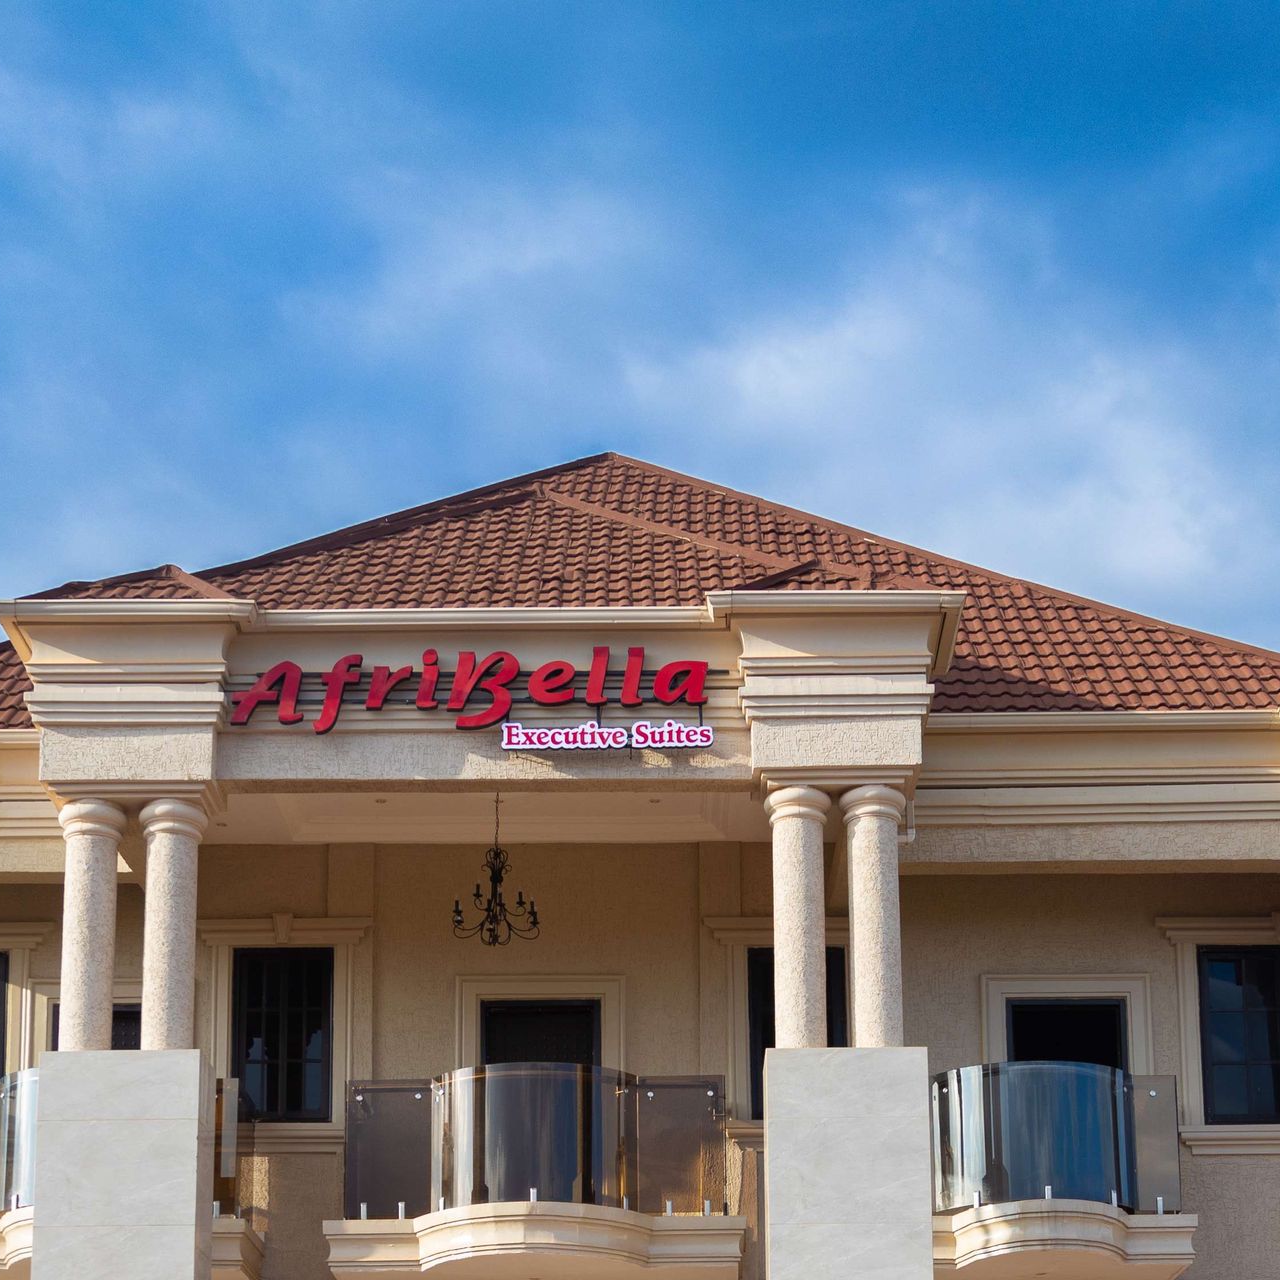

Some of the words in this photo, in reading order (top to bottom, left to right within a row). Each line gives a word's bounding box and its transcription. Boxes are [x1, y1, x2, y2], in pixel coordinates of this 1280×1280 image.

[230, 646, 709, 735] AfriBella
[504, 723, 625, 746] Executive
[635, 721, 711, 745] Suites
